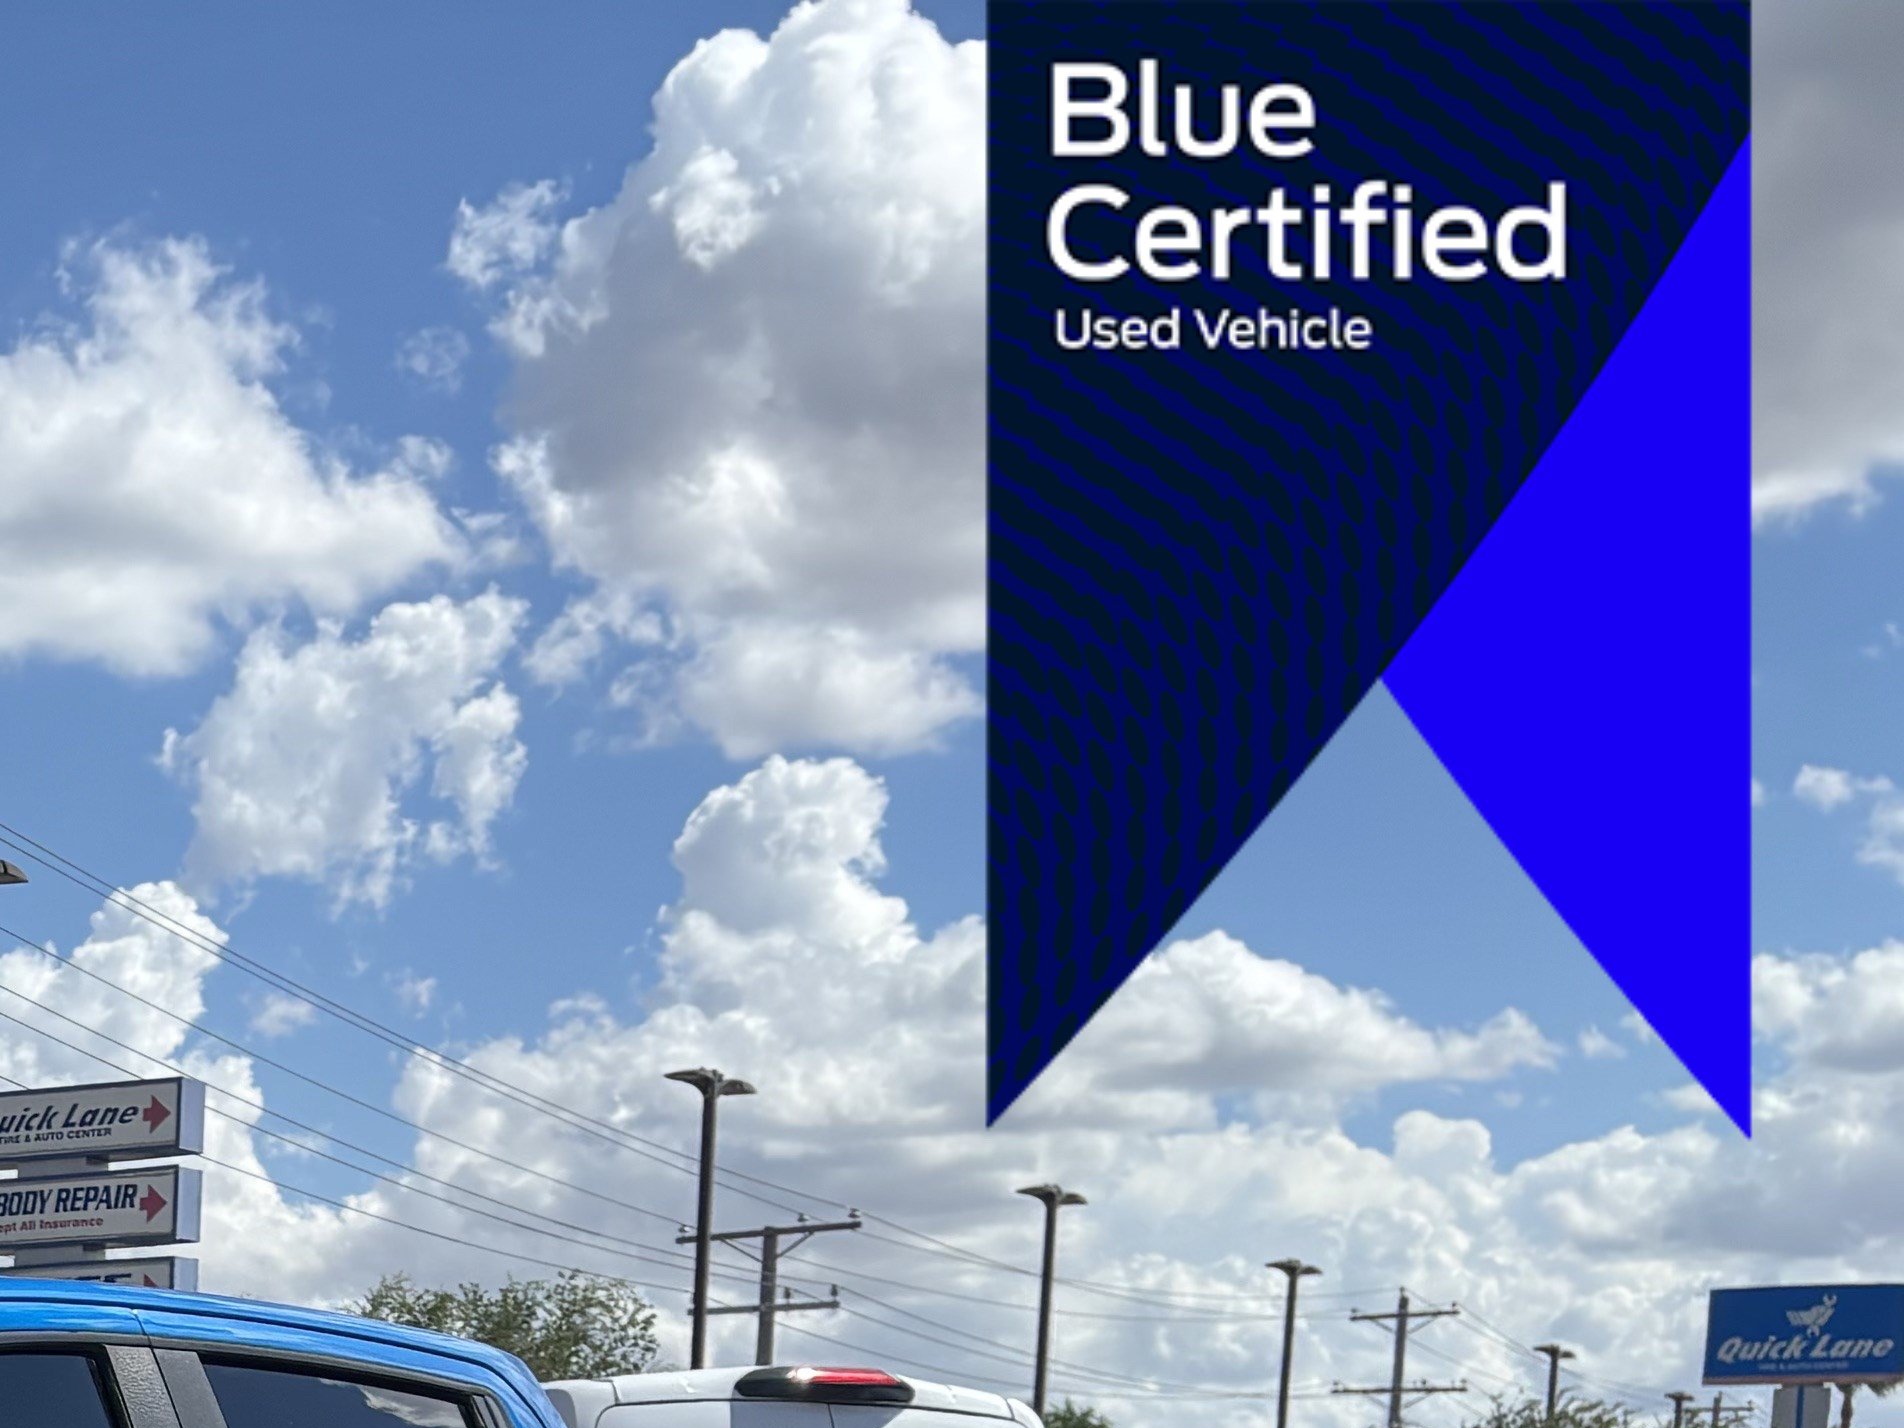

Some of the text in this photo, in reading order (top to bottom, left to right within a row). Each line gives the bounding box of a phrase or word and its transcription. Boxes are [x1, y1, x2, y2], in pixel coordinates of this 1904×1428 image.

[62, 1102, 140, 1129] Lane
[35, 1131, 64, 1142] AUTO
[67, 1127, 112, 1139] CENTER
[55, 1183, 138, 1213] REPAIR
[1717, 1333, 1894, 1365] Quick Lane
